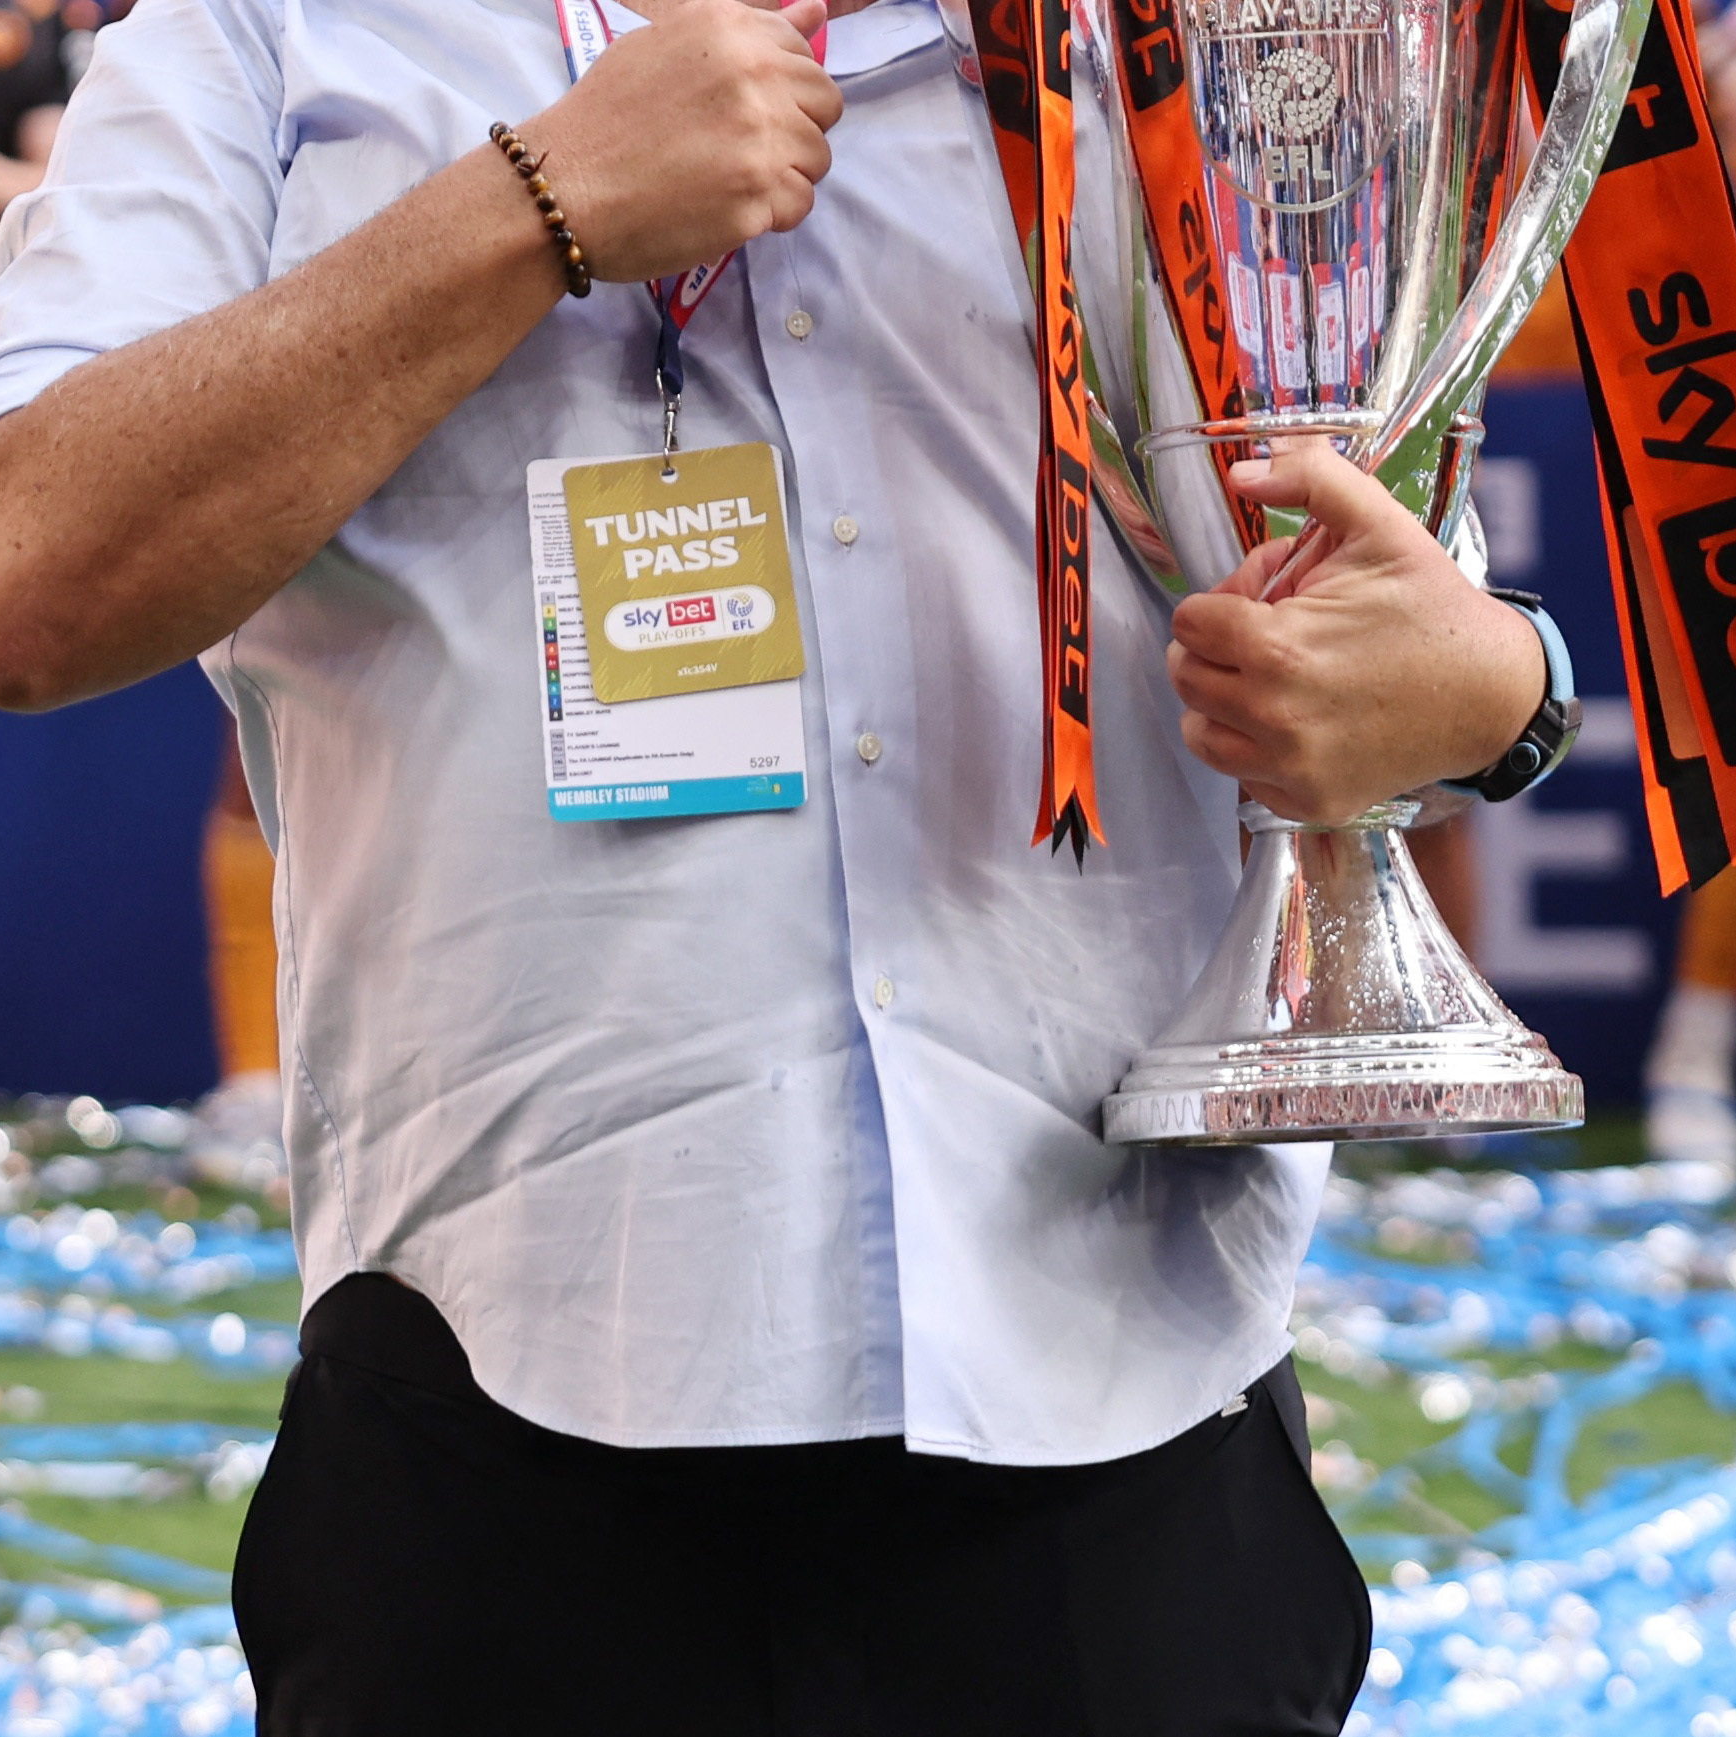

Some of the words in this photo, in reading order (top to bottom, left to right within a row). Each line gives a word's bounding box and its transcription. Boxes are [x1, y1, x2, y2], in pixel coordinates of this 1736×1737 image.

[574, 9, 598, 62] AY-OFFS
[1263, 144, 1332, 182] EFL
[584, 496, 767, 546] TUNNEL
[623, 535, 740, 579] PASS
[623, 607, 662, 628] sky
[670, 599, 711, 622] bet
[732, 618, 755, 631] EFL
[639, 625, 707, 644] PLAY-OFFS
[749, 755, 781, 769] 5297
[554, 787, 614, 807] WEMBLEY
[615, 785, 670, 803] STADIUM
